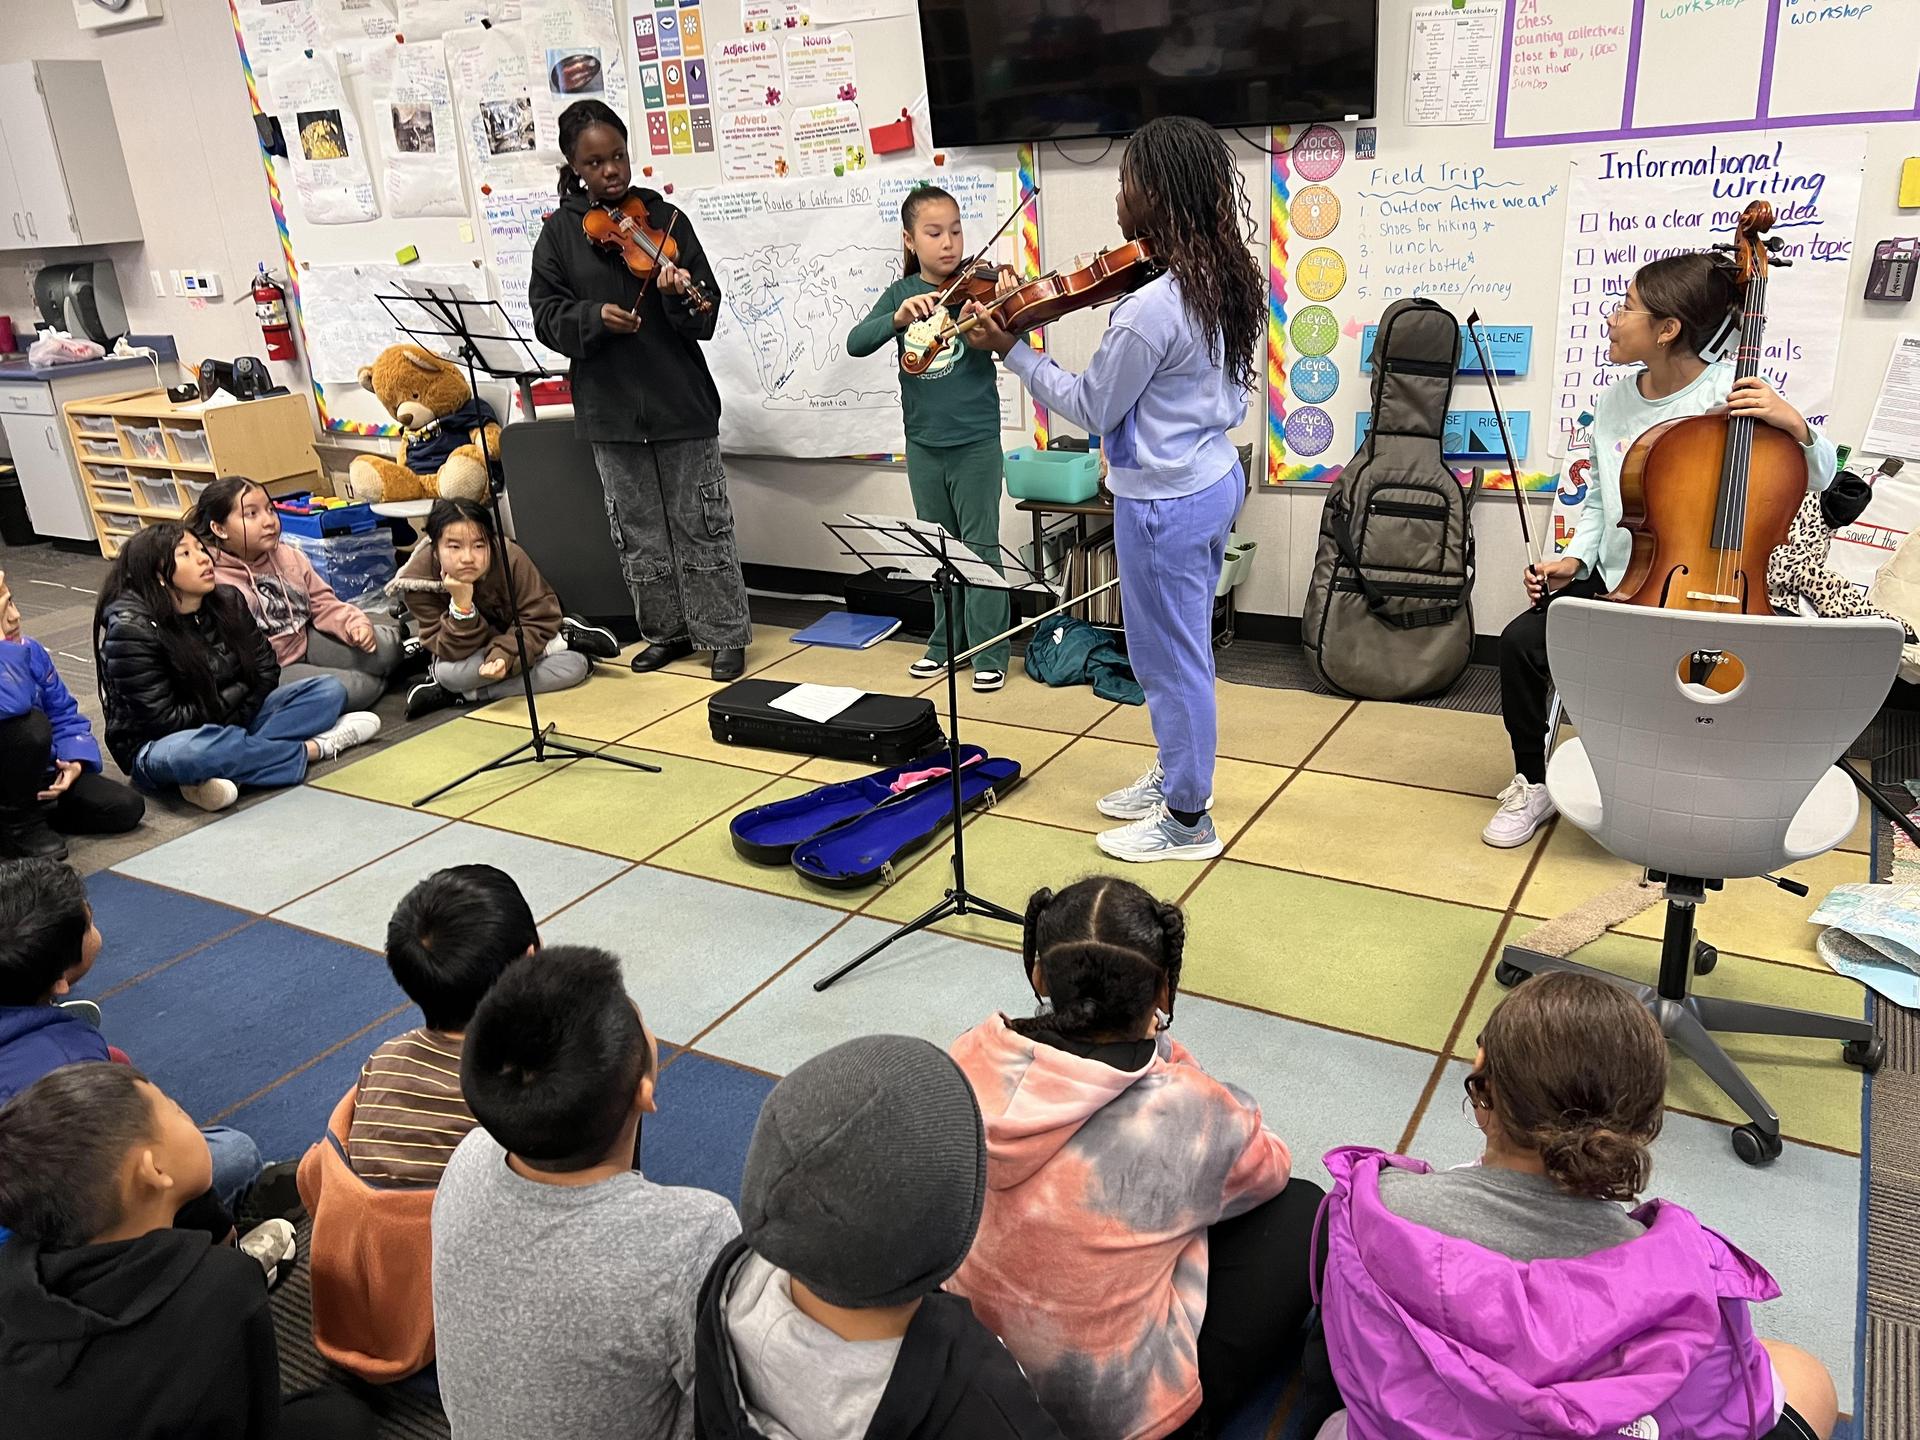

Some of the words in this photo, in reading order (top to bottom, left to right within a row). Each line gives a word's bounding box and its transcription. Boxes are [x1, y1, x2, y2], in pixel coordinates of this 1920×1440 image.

[1463, 7, 1498, 16] Vocabulary
[802, 36, 832, 47] Nouns
[723, 41, 767, 56] Adjective
[1546, 63, 1572, 74] Hour
[810, 107, 837, 119] Verbs
[734, 114, 767, 126] Adverb
[1598, 141, 1782, 180] Informational
[1371, 164, 1425, 187] Field
[1440, 161, 1485, 190] Trip
[1712, 172, 1826, 206] Writing
[763, 191, 793, 211] Routes
[799, 192, 806, 209] to
[810, 190, 843, 207] California
[1380, 201, 1442, 217] Outdoor
[1451, 195, 1498, 212] Active
[1609, 210, 1639, 232] has
[1645, 214, 1656, 229] a
[1663, 209, 1704, 229] clear
[1711, 210, 1741, 227] ma
[1774, 201, 1818, 222] idea
[491, 224, 528, 240] immigrant
[1417, 217, 1431, 233] for
[1438, 219, 1478, 240] hiking
[1389, 238, 1444, 255] lunch
[1604, 245, 1636, 265] well
[1782, 243, 1803, 257] on
[1809, 232, 1852, 262] topic
[501, 278, 527, 290] route
[1383, 286, 1402, 298] no
[504, 300, 529, 310] mine
[1311, 325, 1319, 337] 2
[1468, 333, 1524, 343] SCALENE
[1764, 338, 1802, 361] ails
[1311, 372, 1319, 383] 3
[808, 398, 848, 408] Antarctica
[1306, 425, 1313, 436] 4
[1845, 528, 1878, 544] saved
[1882, 530, 1898, 549] the
